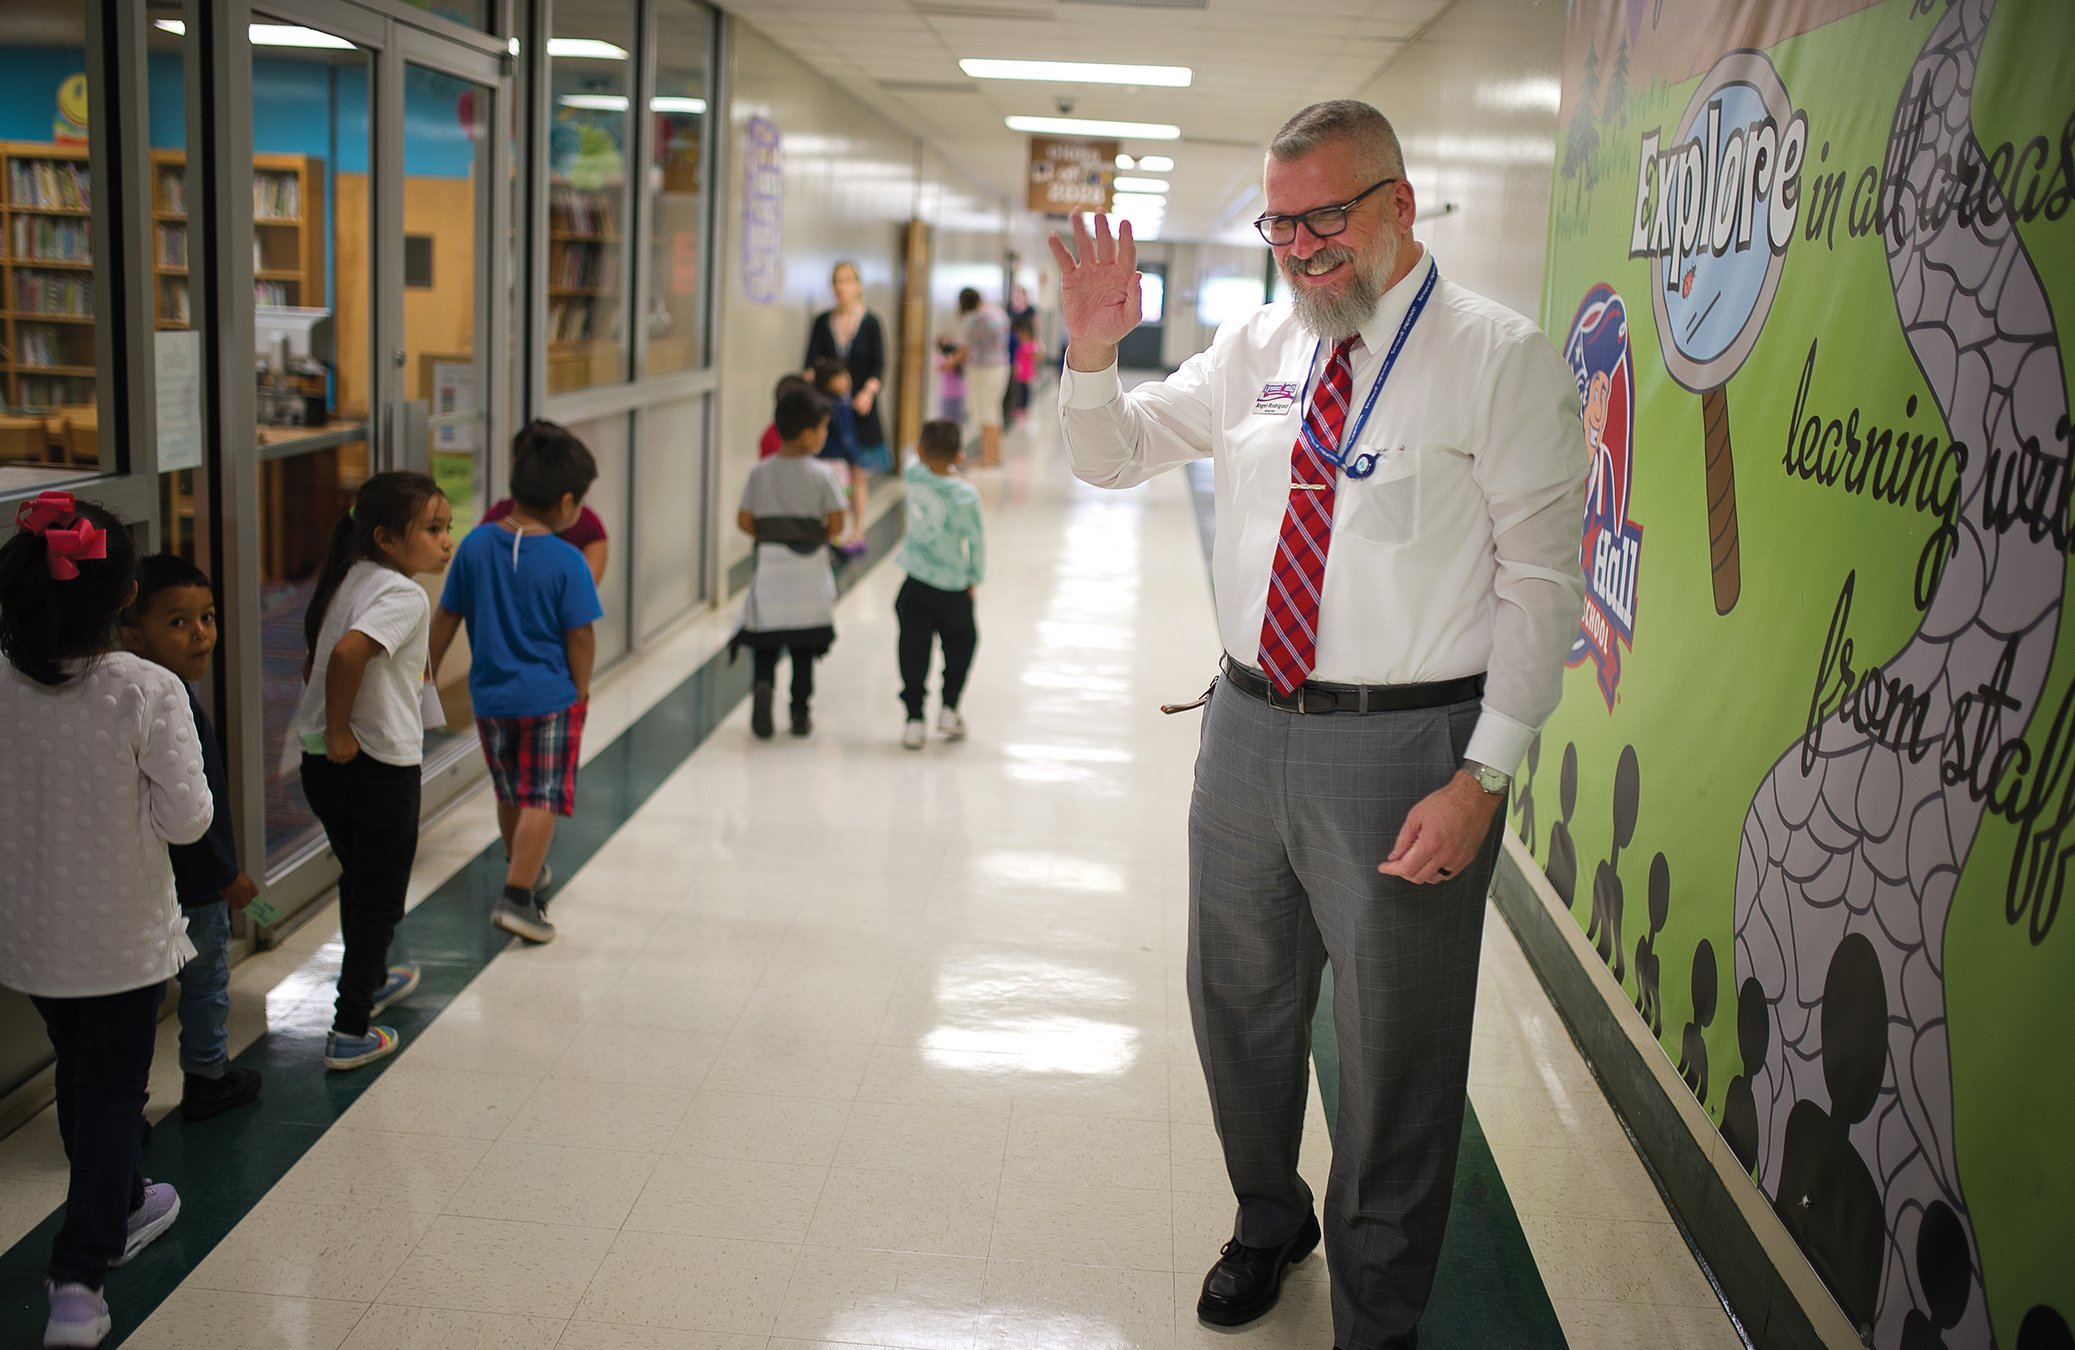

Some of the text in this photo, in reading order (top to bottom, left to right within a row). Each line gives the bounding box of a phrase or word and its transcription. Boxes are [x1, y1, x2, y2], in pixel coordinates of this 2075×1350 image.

[1629, 98, 1808, 292] Explore
[1805, 141, 1846, 250] in
[1782, 337, 1969, 612] learning
[1593, 527, 1639, 632] Hall
[1801, 569, 1933, 778] from
